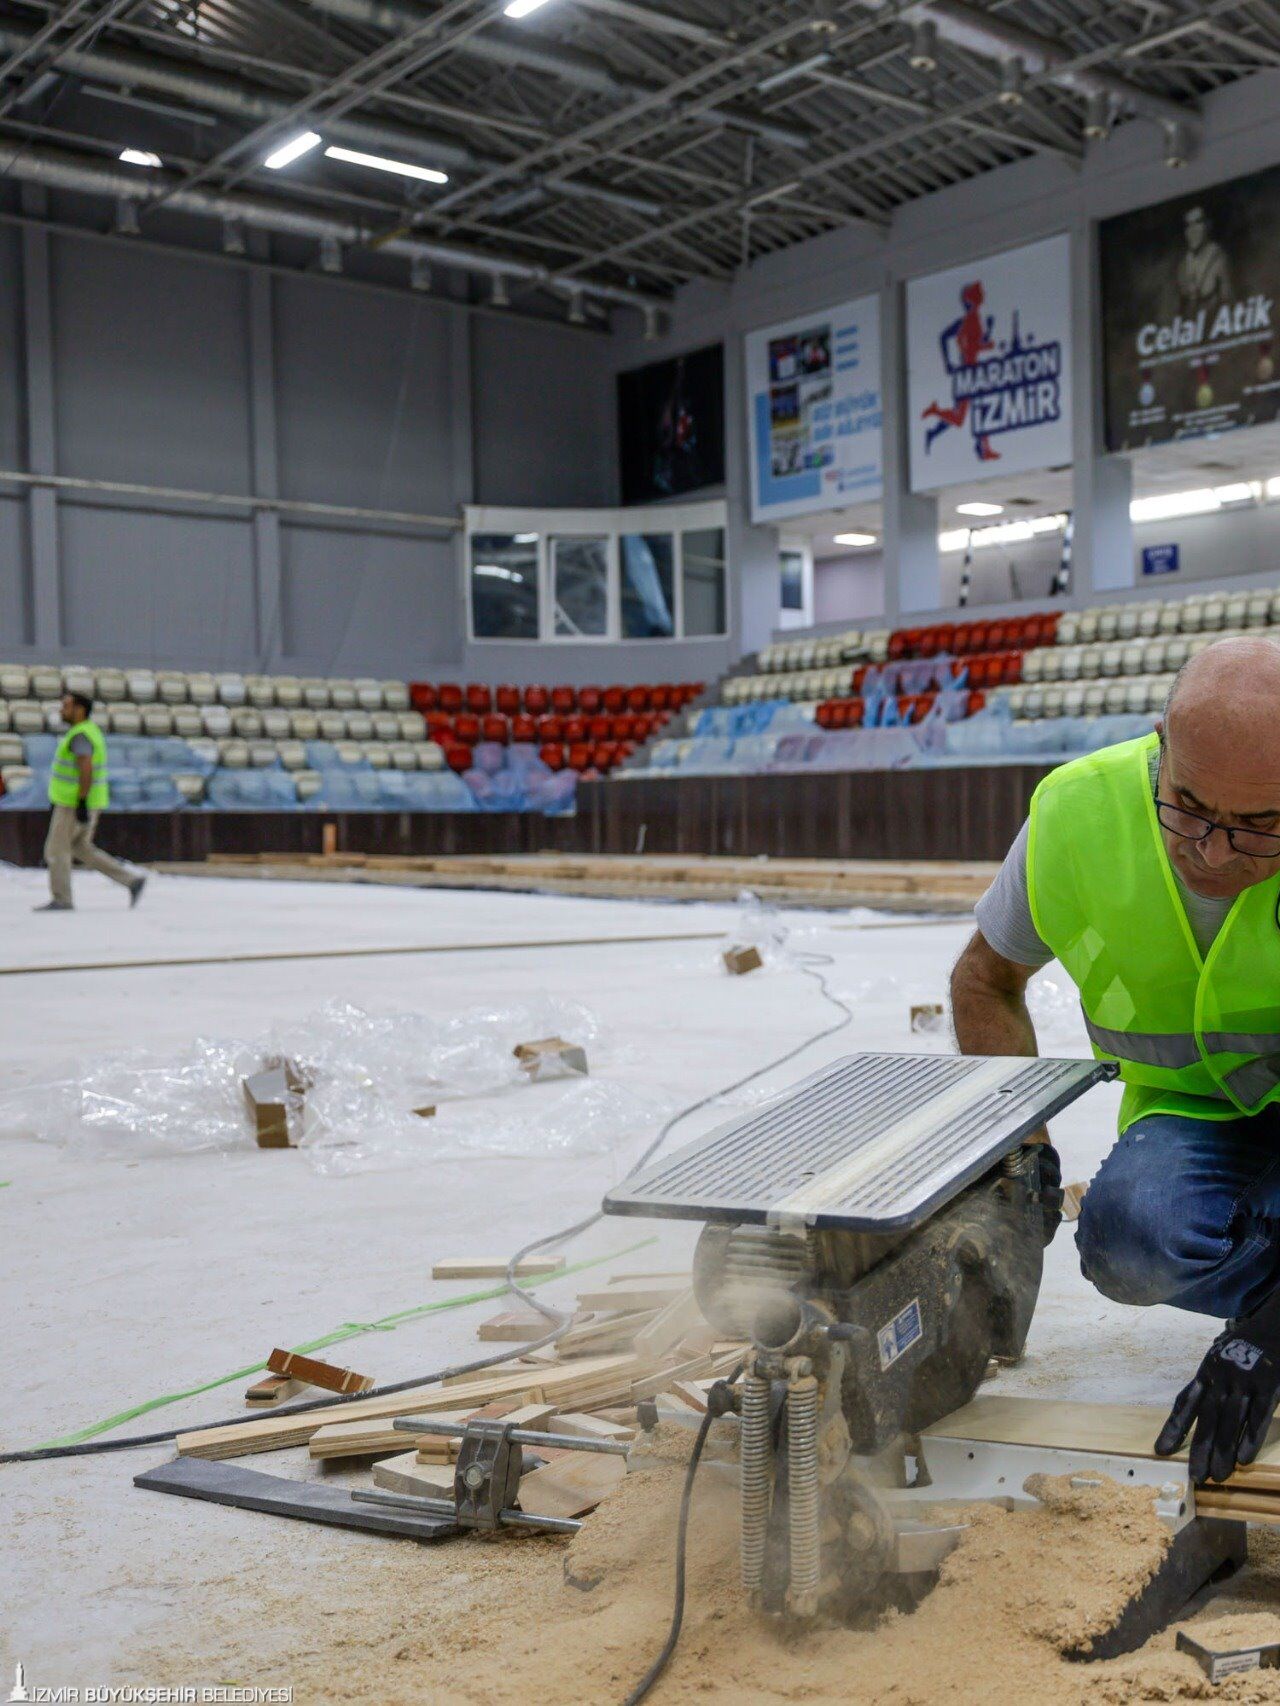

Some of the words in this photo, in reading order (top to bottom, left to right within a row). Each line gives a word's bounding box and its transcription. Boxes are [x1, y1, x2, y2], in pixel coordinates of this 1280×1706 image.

[1137, 310, 1207, 355] Celal
[1209, 294, 1274, 339] Atik
[956, 349, 1058, 397] MARATON
